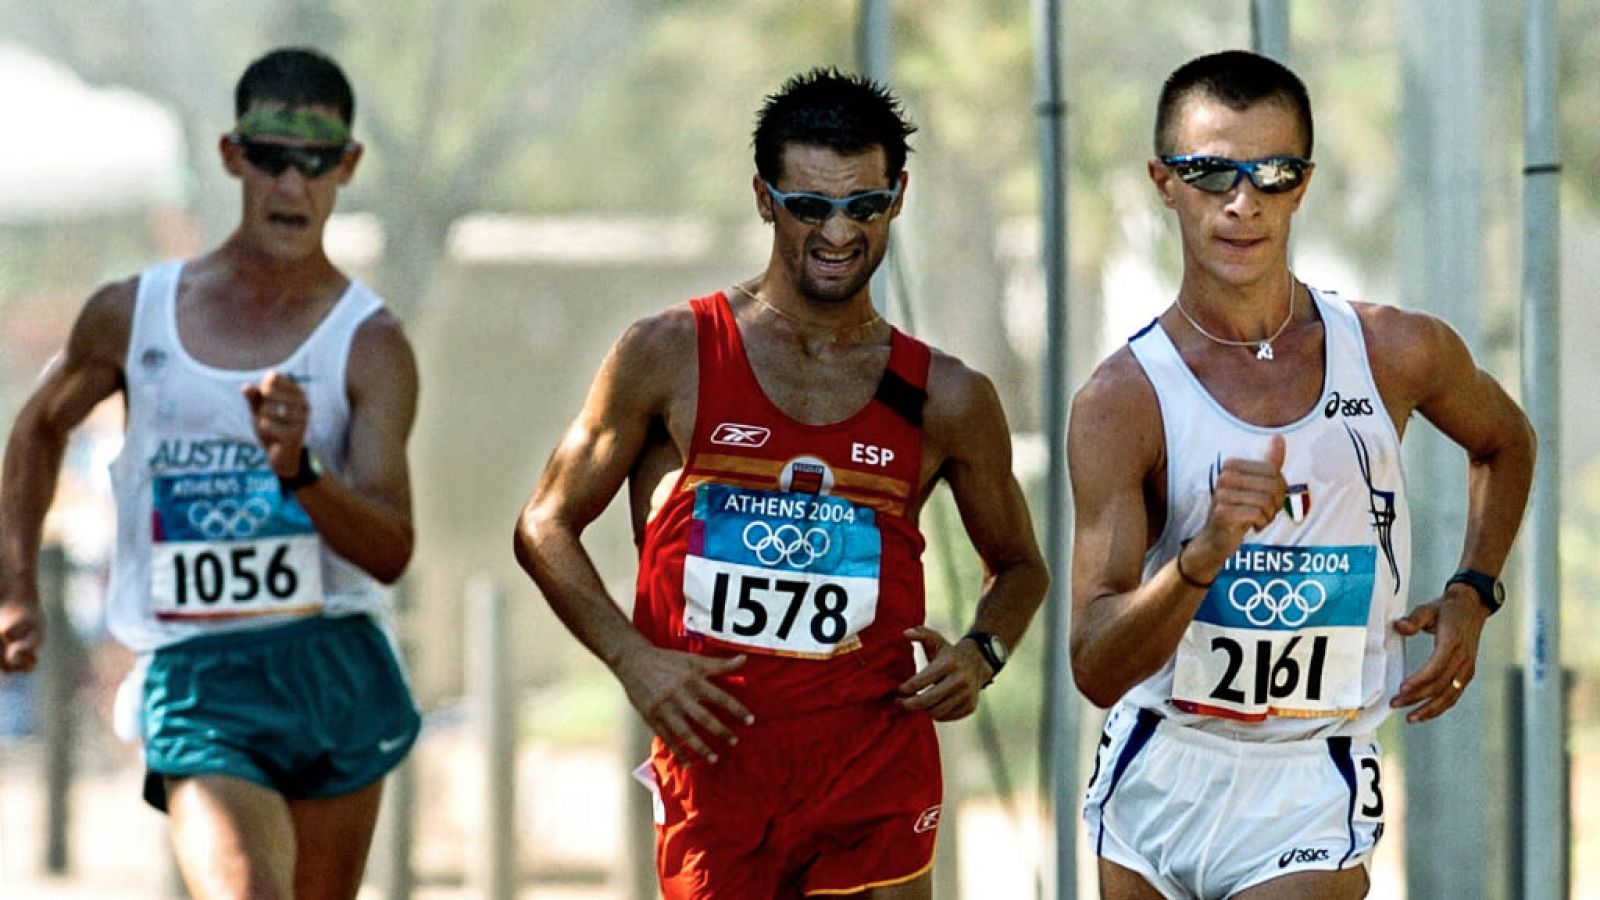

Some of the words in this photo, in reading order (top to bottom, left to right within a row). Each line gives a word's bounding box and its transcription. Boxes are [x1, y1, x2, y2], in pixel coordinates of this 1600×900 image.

[851, 441, 895, 468] ESP
[724, 493, 806, 519] ATHENS
[808, 502, 855, 524] 2004
[174, 544, 297, 605] 1056
[1299, 551, 1350, 573] 2004
[710, 572, 849, 644] 1578
[1209, 635, 1329, 705] 2161
[1361, 757, 1384, 817] 3
